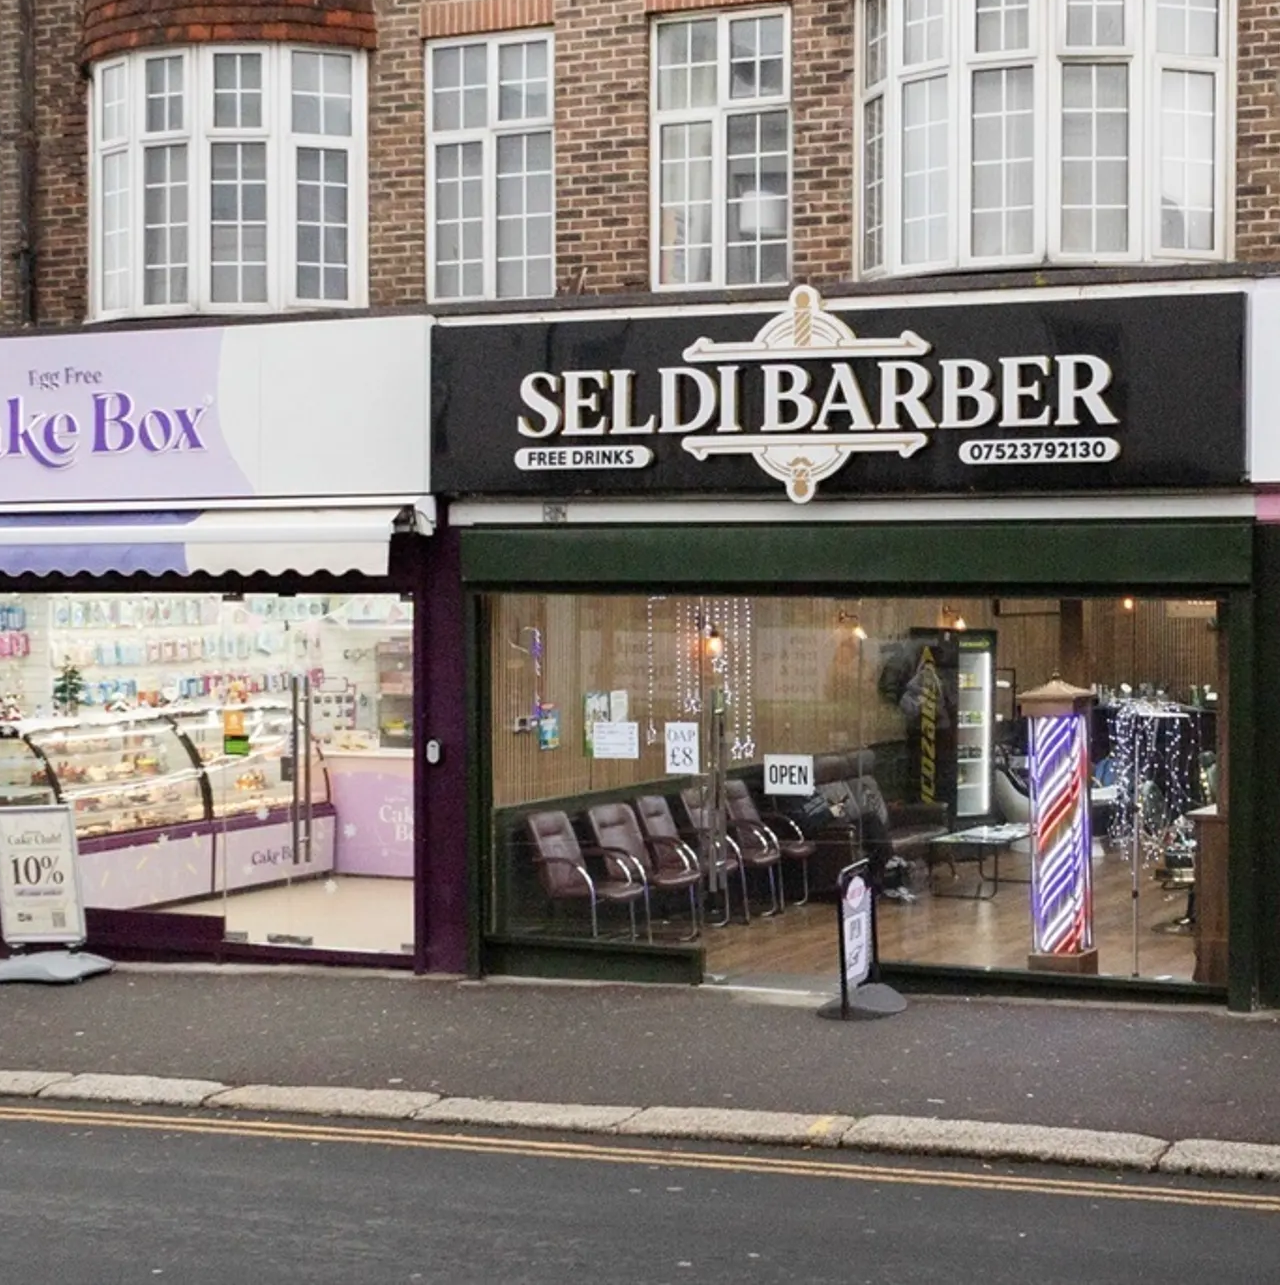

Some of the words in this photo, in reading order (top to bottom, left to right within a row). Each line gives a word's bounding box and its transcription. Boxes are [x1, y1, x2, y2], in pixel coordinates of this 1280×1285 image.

[28, 369, 60, 390] Egg
[64, 366, 104, 385] Free
[517, 365, 742, 439] SELDI
[760, 353, 1120, 432] BARBER
[91, 389, 209, 454] Box
[527, 450, 567, 466] FREE
[572, 449, 635, 465] DRINKS
[969, 440, 1106, 462] 07523792130
[667, 729, 696, 742] OAP
[670, 746, 694, 767] £8
[769, 764, 808, 785] OPEN
[11, 855, 64, 885] 10%
